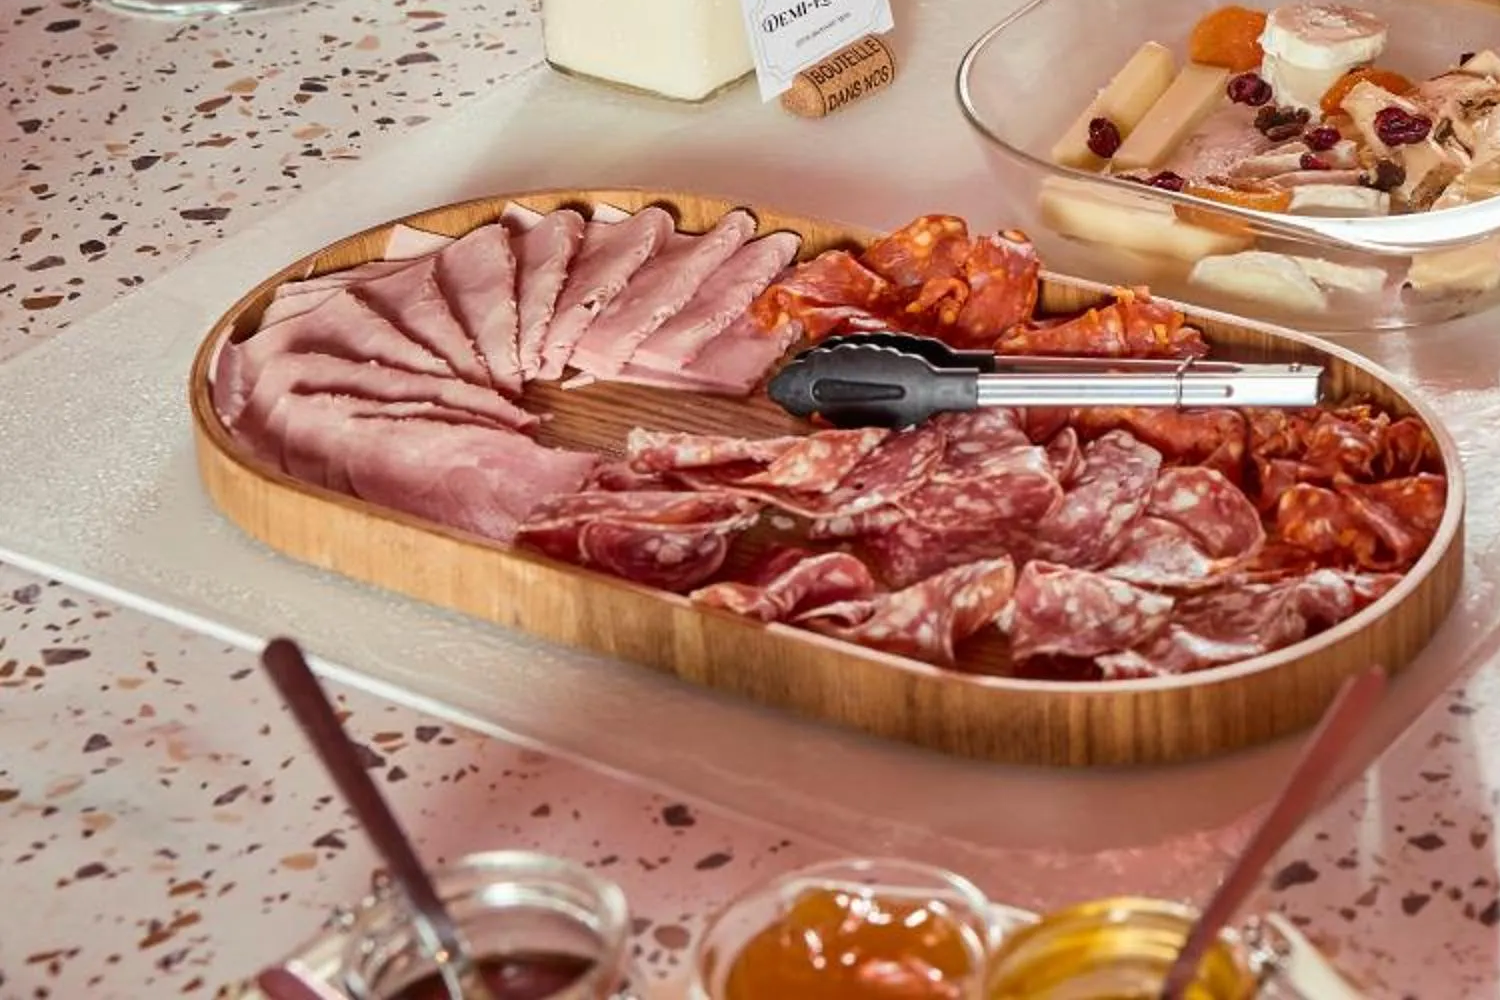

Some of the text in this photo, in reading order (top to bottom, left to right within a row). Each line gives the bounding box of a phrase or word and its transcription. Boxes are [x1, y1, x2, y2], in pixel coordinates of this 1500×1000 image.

[810, 39, 880, 85] BOUTEILLE
[827, 65, 889, 112] DANS NOS
